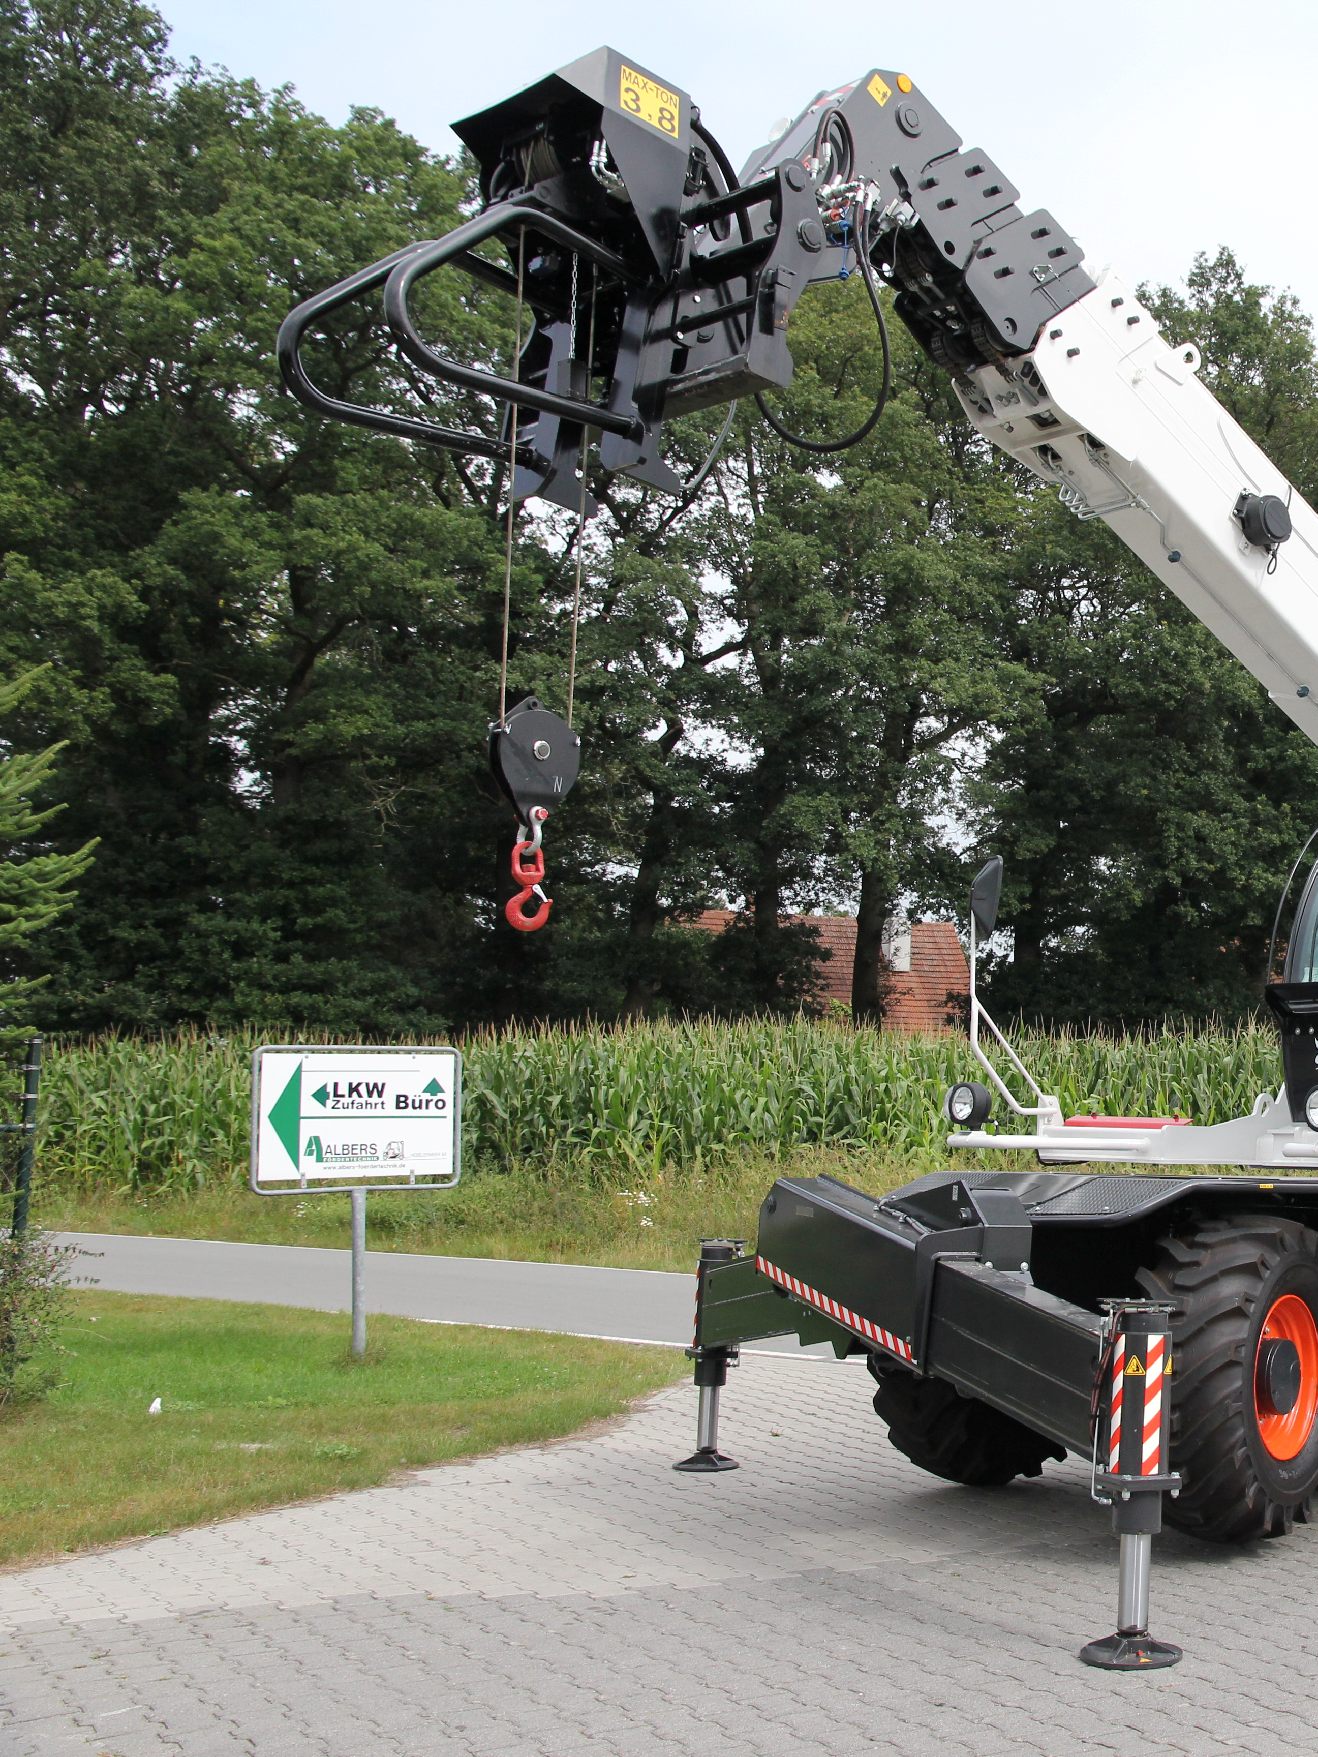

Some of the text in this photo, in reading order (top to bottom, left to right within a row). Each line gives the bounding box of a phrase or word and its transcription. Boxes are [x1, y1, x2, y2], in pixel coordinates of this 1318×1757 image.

[622, 68, 678, 109] MAX-TON
[623, 87, 676, 133] 3,8
[332, 1081, 386, 1099] LKW
[331, 1099, 386, 1110] Zufahrt
[395, 1094, 446, 1110] Büro
[324, 1143, 378, 1156] ALBERS
